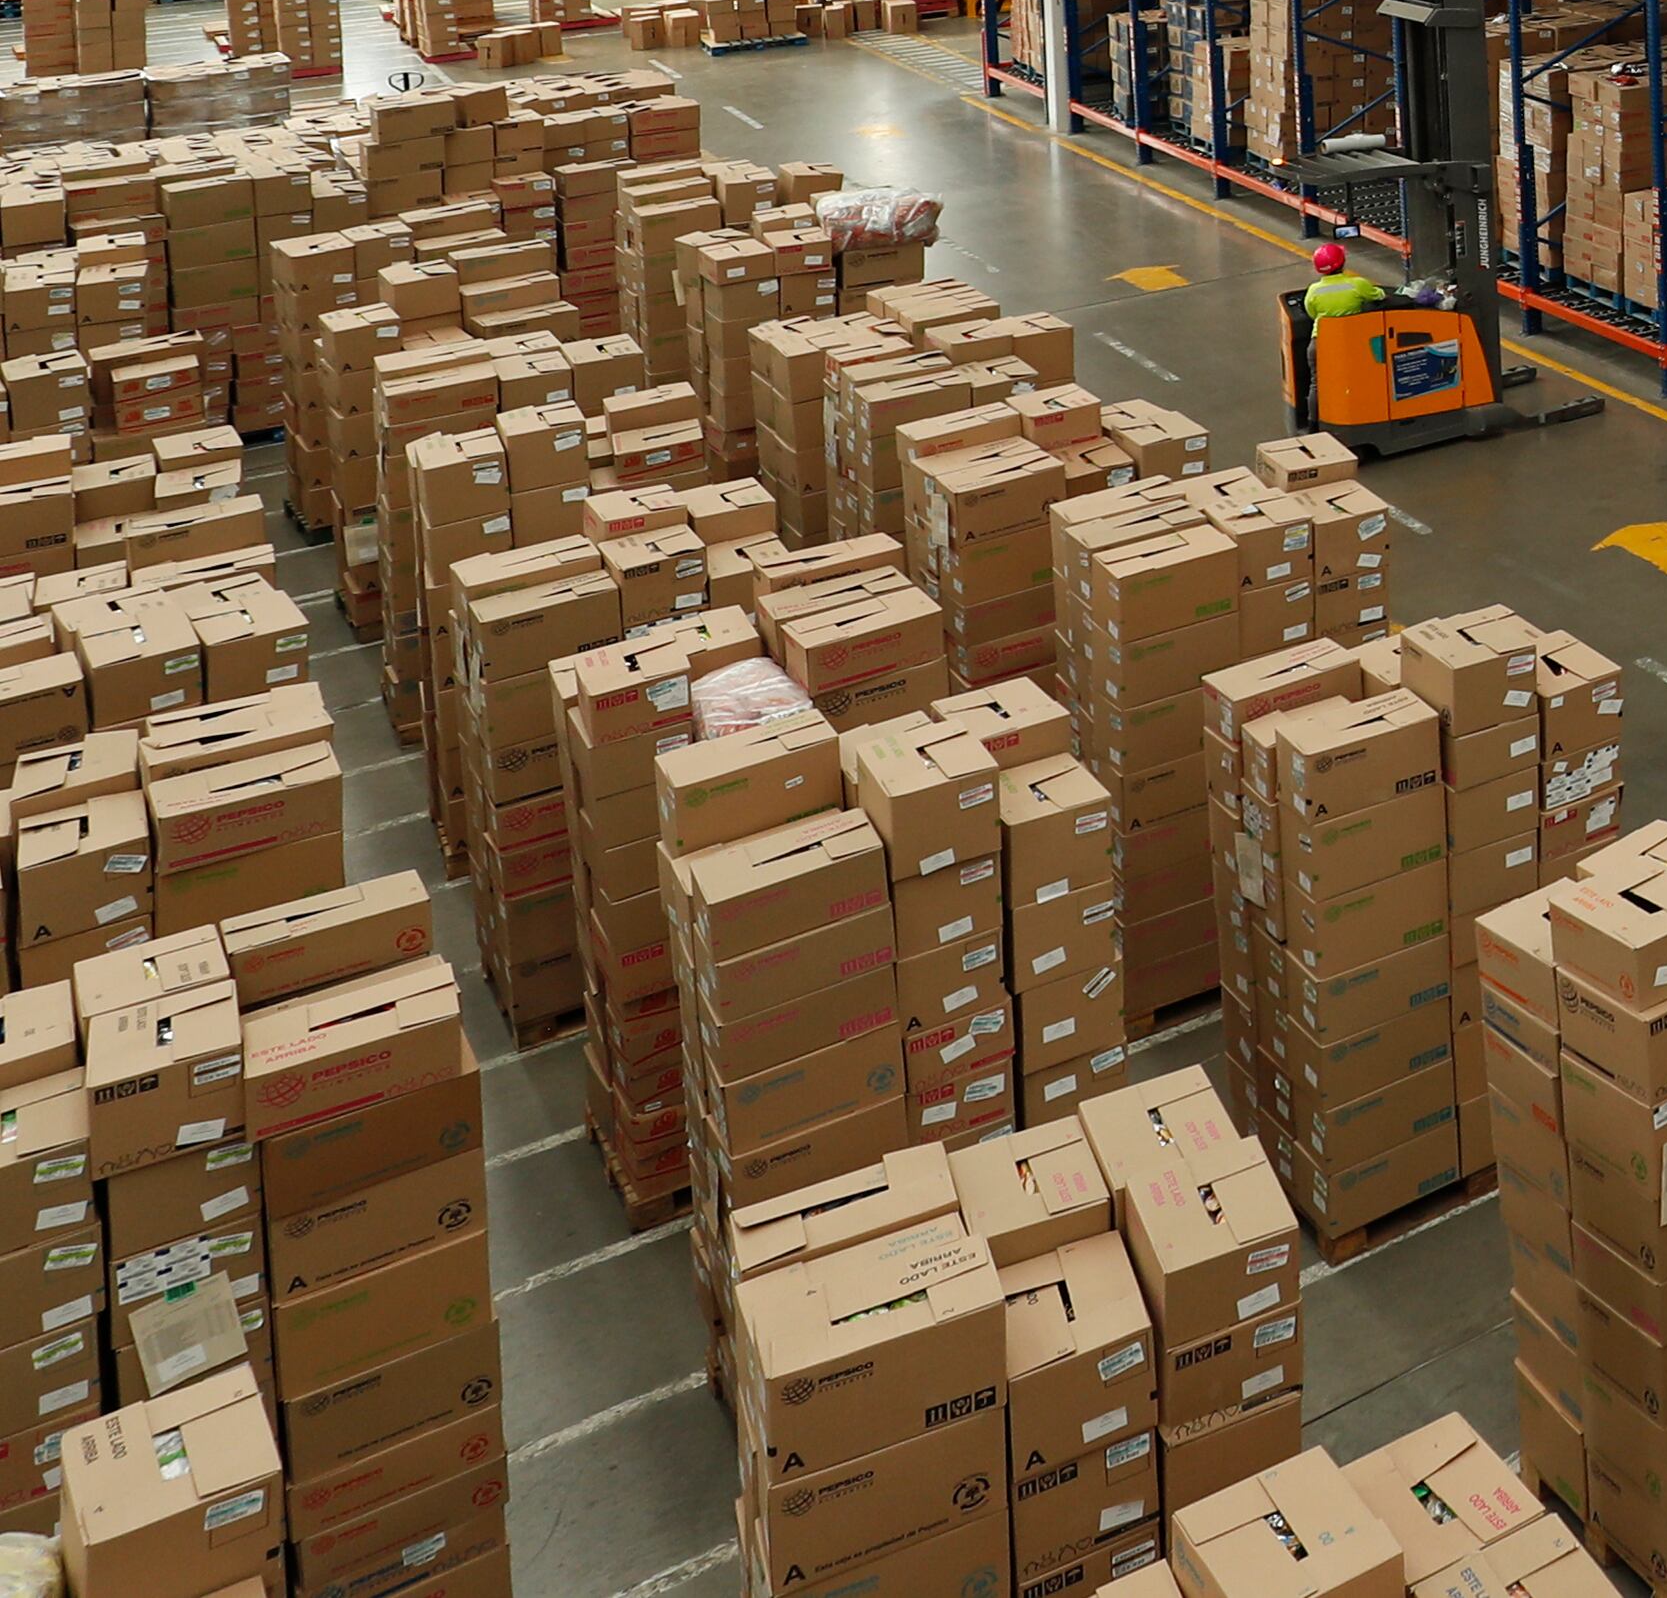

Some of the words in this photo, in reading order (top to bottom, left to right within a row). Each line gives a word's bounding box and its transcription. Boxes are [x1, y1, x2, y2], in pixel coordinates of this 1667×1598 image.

[1478, 198, 1490, 269] JUNGHEINRICH
[803, 484, 812, 492] A
[965, 530, 976, 541] A
[1321, 565, 1332, 576] A
[1241, 576, 1253, 587] A
[437, 626, 448, 636] A
[852, 632, 902, 653] PEPSICO
[1002, 637, 1044, 654] PEPSICO
[445, 676, 455, 686] A
[855, 678, 907, 699] PEPSICO
[1273, 682, 1321, 704] PEPSICO
[1334, 748, 1367, 761] PEPSICO
[1551, 742, 1564, 755] A
[452, 786, 463, 795] A
[216, 800, 286, 824] PEPSICO
[1315, 804, 1329, 816] A
[33, 925, 51, 941] A
[1459, 1011, 1472, 1024] A
[1579, 996, 1616, 1023] PEPSICO
[905, 1016, 922, 1031] A
[250, 1043, 288, 1059] ESTE
[289, 1033, 328, 1048] LADO
[264, 1044, 317, 1065] ARRIBA
[311, 1050, 393, 1081] PEPSICO
[770, 1144, 812, 1164] PEPSICO
[909, 1247, 962, 1270] ARRIBA
[936, 1252, 977, 1272] ESTE
[288, 1276, 307, 1294] A
[899, 1265, 938, 1285] LADO
[817, 1361, 874, 1385] PEPSICO
[104, 1416, 123, 1440] ESTE
[81, 1434, 100, 1465] ARRIBA
[110, 1436, 127, 1460] LADO
[781, 1452, 805, 1474] A
[1025, 1450, 1046, 1471] A
[818, 1470, 875, 1495] PEPSICO
[1468, 1493, 1491, 1515] LADO
[1493, 1485, 1522, 1516] ARRIBA
[1484, 1509, 1508, 1532] ESTE
[783, 1564, 806, 1587] A
[1460, 1566, 1483, 1589] ESTE
